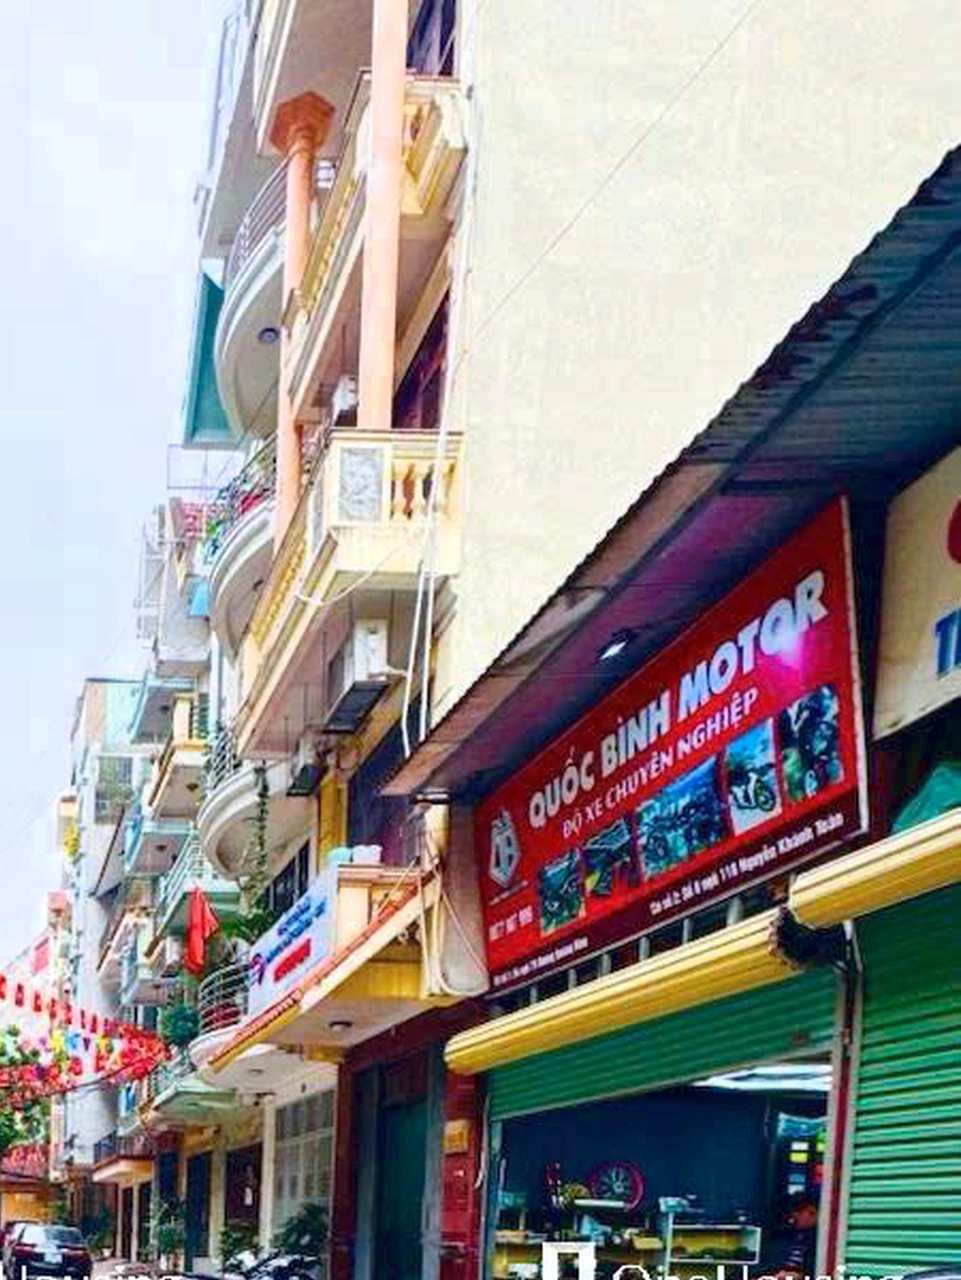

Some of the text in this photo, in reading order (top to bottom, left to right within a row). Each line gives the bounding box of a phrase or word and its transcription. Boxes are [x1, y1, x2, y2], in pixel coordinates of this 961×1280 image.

[529, 745, 595, 828] QUỐC
[600, 690, 671, 778] BÌNH
[678, 570, 829, 723] MOTOR
[585, 797, 604, 823] XE
[605, 746, 673, 809] CHUYÊN
[677, 686, 758, 760] NGHIỆP
